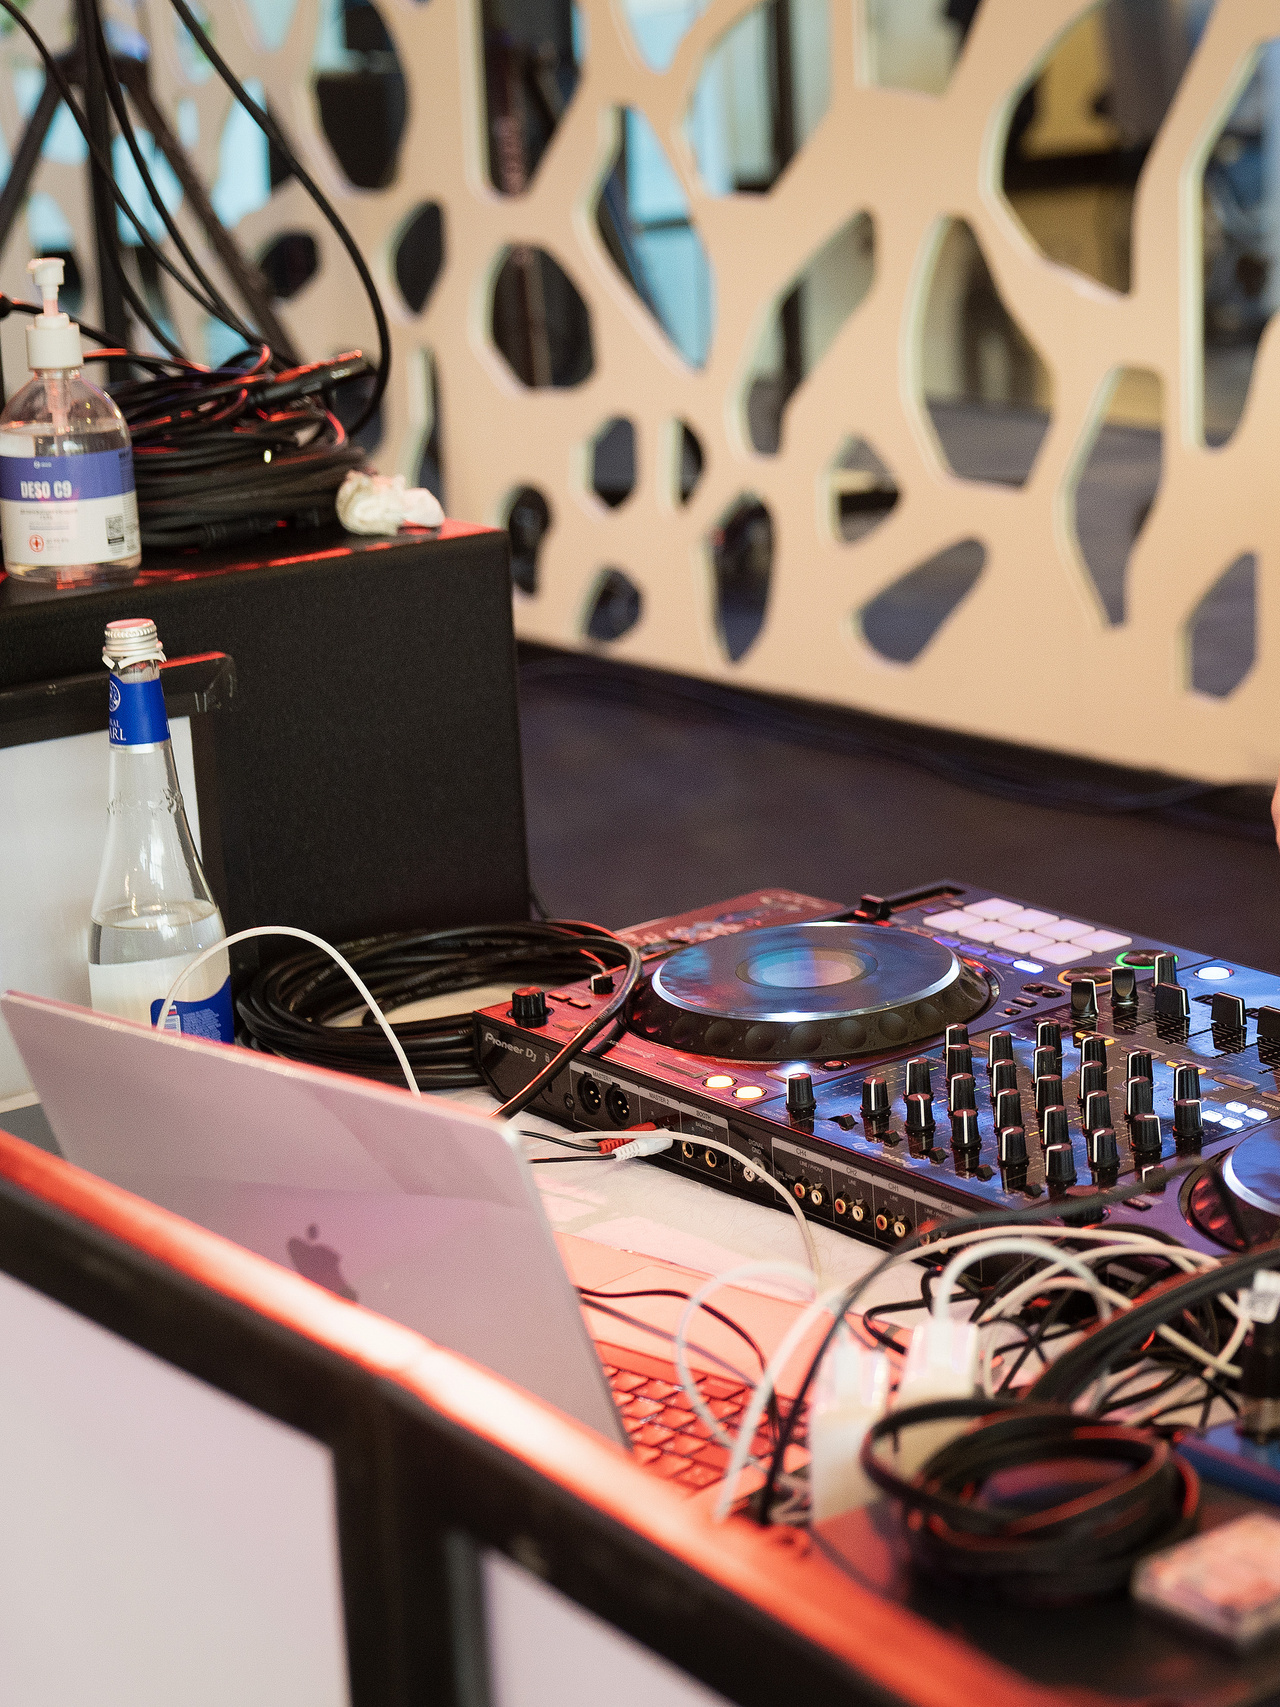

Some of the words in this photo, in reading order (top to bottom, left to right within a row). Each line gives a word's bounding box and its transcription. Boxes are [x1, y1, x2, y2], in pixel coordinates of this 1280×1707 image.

[21, 481, 50, 499] DESO
[54, 480, 72, 498] C9
[484, 1031, 524, 1055] Pioneer
[696, 1110, 713, 1121] BOOTH
[795, 1147, 807, 1157] CH4
[845, 1167, 858, 1177] CH2
[887, 1182, 899, 1192] CH1
